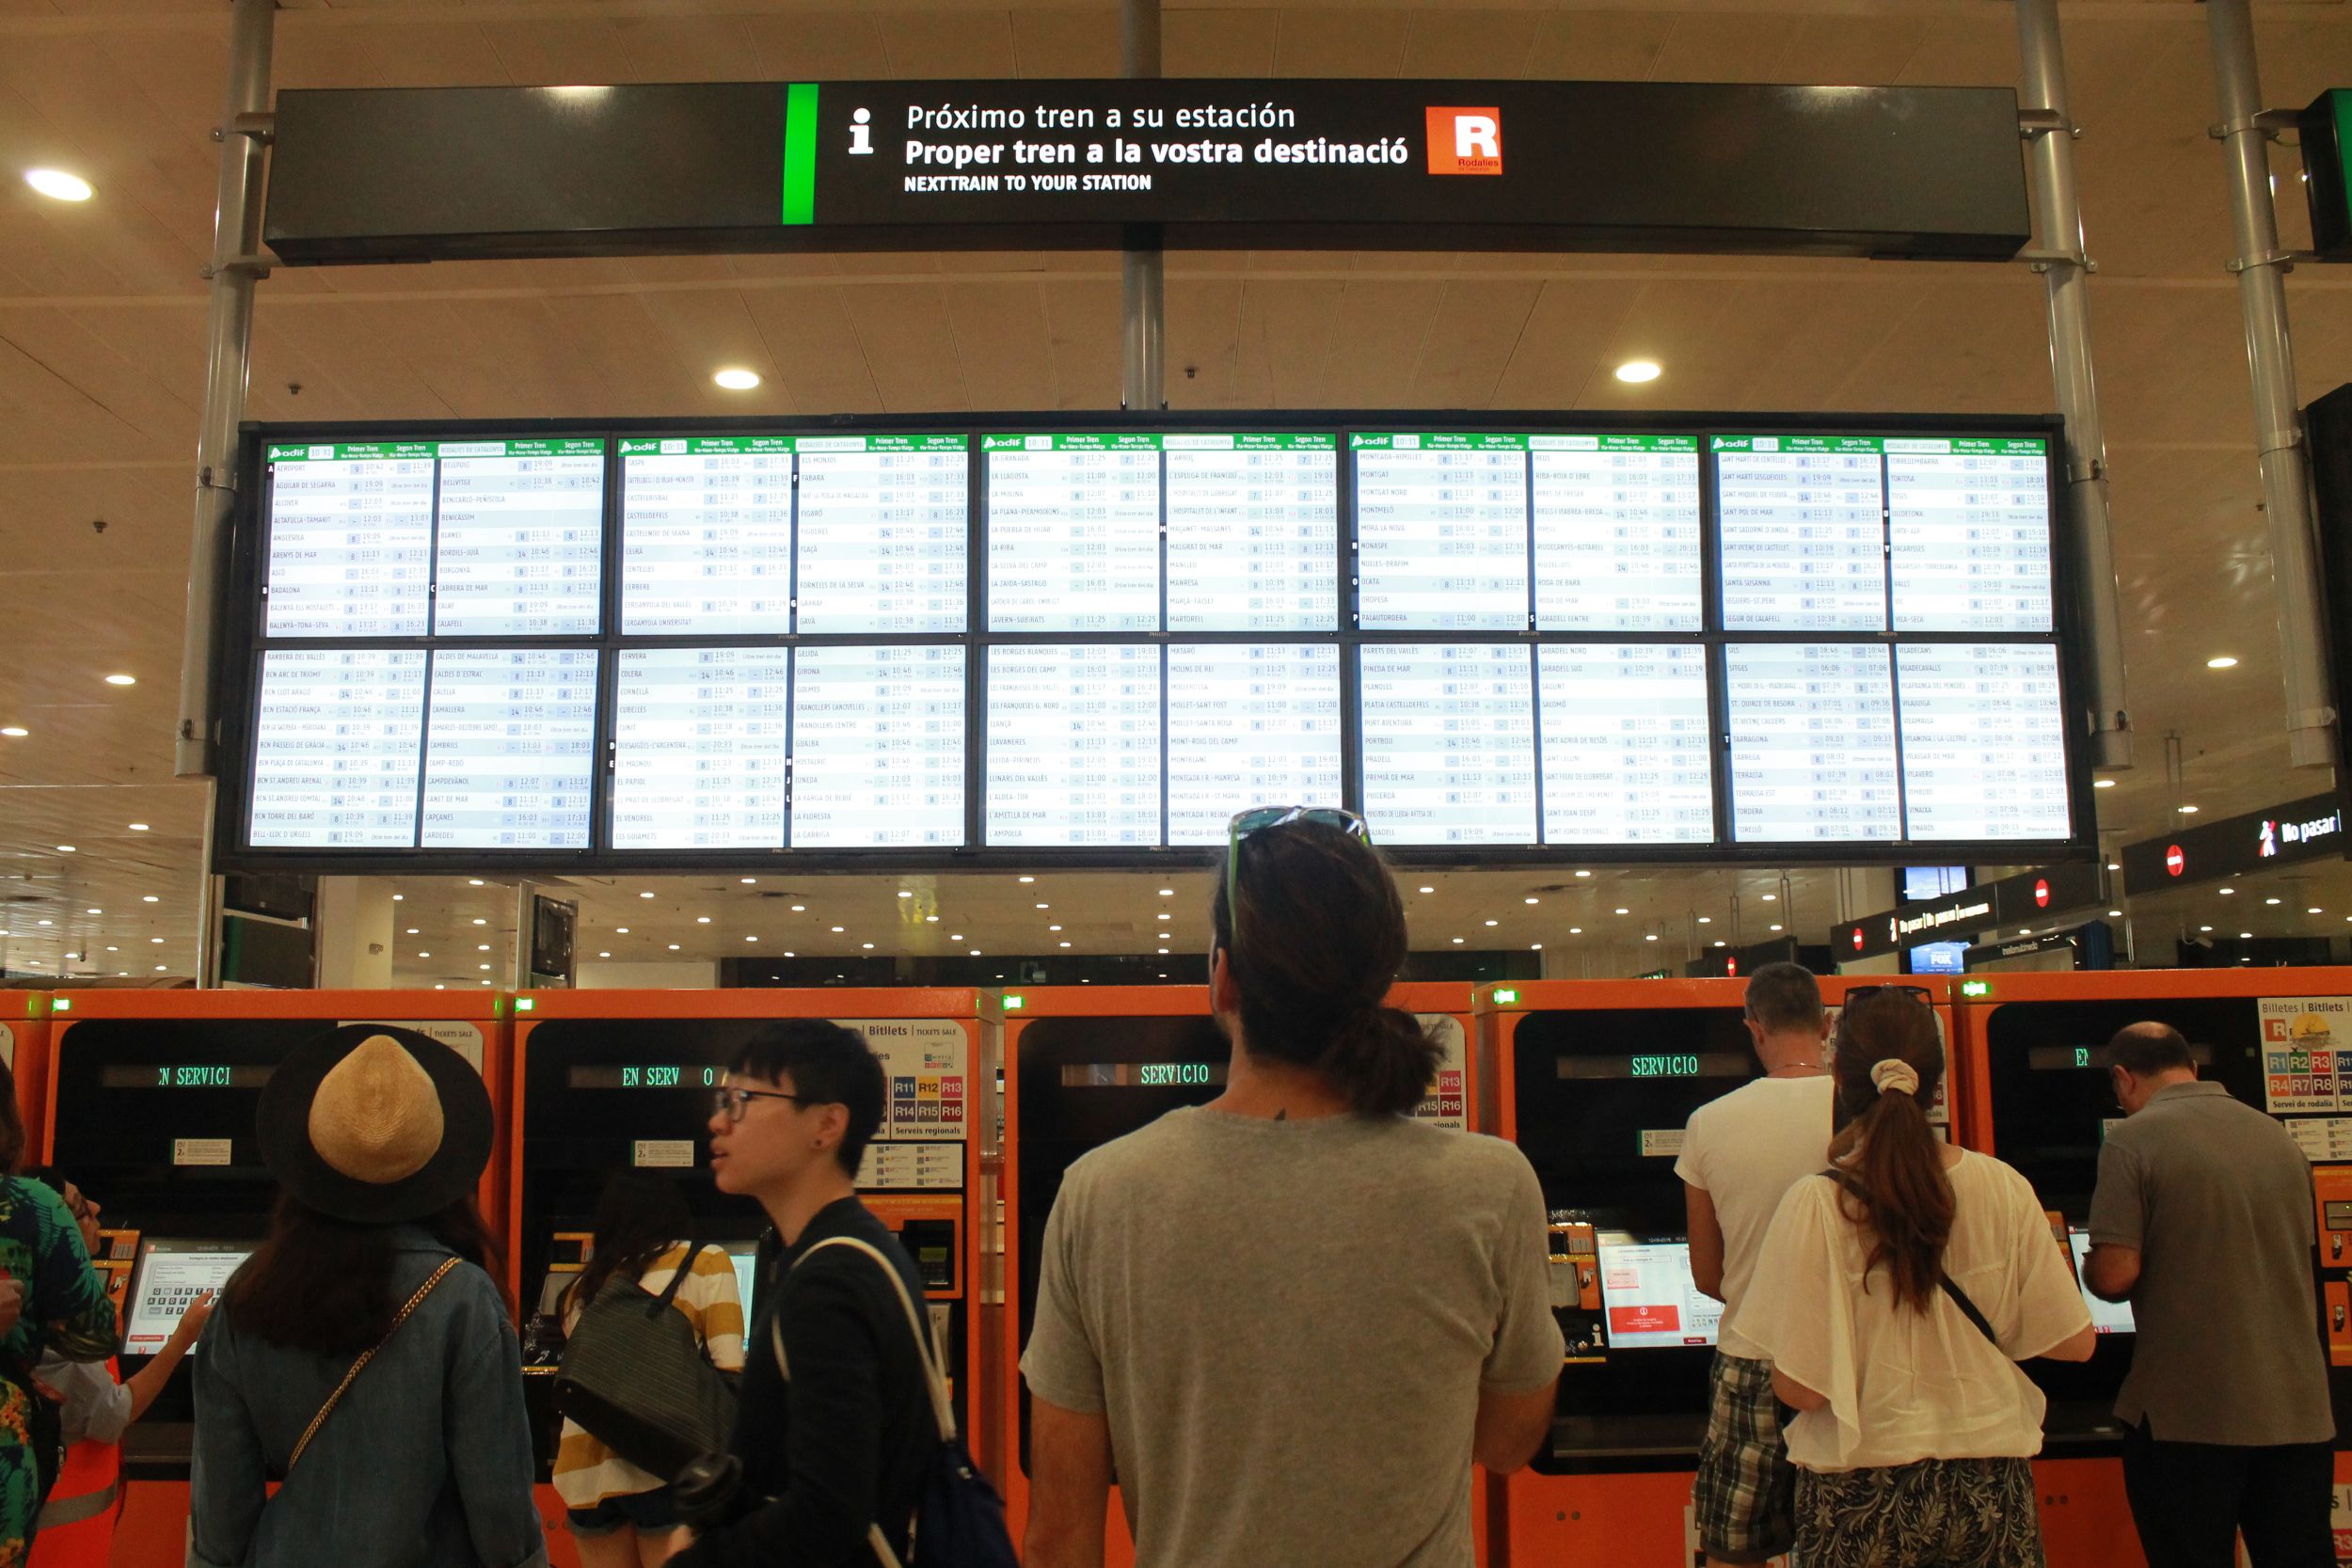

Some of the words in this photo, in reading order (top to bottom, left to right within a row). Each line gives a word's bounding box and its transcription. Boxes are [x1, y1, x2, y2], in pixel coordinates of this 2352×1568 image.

[908, 103, 1025, 130] Próximo
[1035, 105, 1093, 128] tren
[1106, 110, 1120, 127] a
[1134, 109, 1163, 127] su
[1176, 103, 1295, 127] estación
[1454, 116, 1499, 156] R
[906, 141, 1004, 169] Proper
[1013, 140, 1074, 163] tren
[1087, 145, 1103, 163] a
[1116, 138, 1140, 163] la
[1151, 139, 1242, 163] vostra
[1254, 137, 1407, 164] destinació
[1004, 175, 1025, 190] TO
[1031, 175, 1077, 190] YOUR
[1083, 175, 1151, 190] STATION
[997, 438, 1021, 447] adif
[1365, 437, 1389, 446] adif
[1724, 439, 1748, 448] adif
[1841, 438, 1858, 447] Segon
[633, 442, 657, 451] adif
[268, 465, 274, 473] A
[793, 474, 798, 483] F
[262, 586, 267, 594] B
[791, 599, 796, 608] G
[610, 742, 615, 751] D
[786, 776, 791, 784] J
[2300, 816, 2336, 843] pasar
[2263, 1004, 2298, 1012] Billetes
[2308, 1003, 2344, 1012] Bitllets
[869, 1025, 907, 1036] Bitllets
[1632, 1055, 1698, 1076] SERVICIO
[2270, 1057, 2286, 1069] R1
[2290, 1056, 2309, 1068] R2
[2312, 1056, 2329, 1068] R3
[177, 1068, 230, 1085] SERVICI
[623, 1068, 639, 1085] EN
[1141, 1065, 1208, 1084] SERVICIO
[1441, 1077, 1460, 1086] R13
[2271, 1081, 2288, 1092] R4
[2293, 1080, 2310, 1091] R7
[2313, 1079, 2333, 1091] R8
[895, 1083, 914, 1092] R11
[919, 1083, 938, 1092] R12
[943, 1083, 961, 1092] R13
[1442, 1101, 1461, 1110] R16
[895, 1106, 914, 1116] R14
[919, 1106, 938, 1116] R15
[943, 1106, 961, 1116] R16
[926, 1127, 961, 1135] regionals
